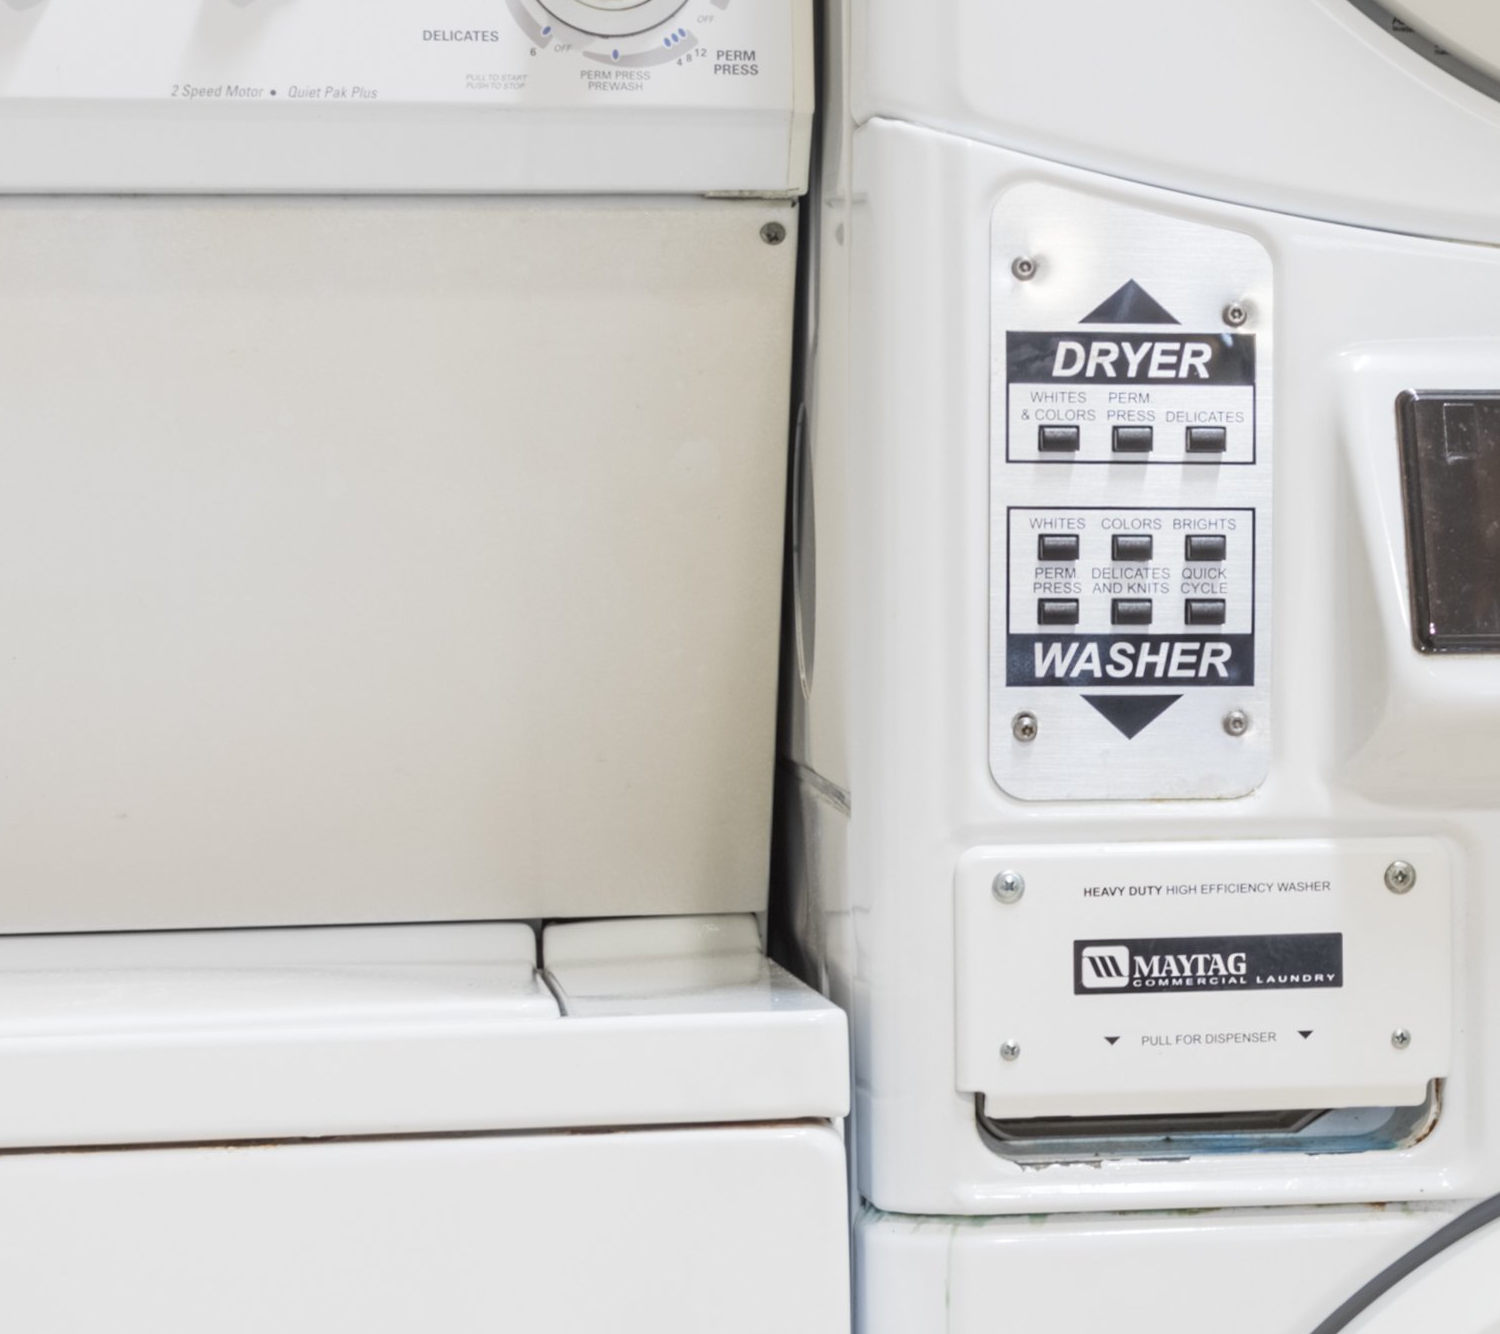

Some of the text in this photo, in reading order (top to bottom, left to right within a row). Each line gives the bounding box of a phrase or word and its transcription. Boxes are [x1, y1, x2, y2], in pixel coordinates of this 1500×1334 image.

[422, 30, 499, 42] DELICATES
[530, 48, 537, 56] 6
[676, 49, 707, 66] 4 8 12
[717, 50, 756, 62] PERM
[580, 70, 651, 81] PERM PRESS
[714, 63, 758, 76] PRESS
[588, 81, 644, 91] PREWASH
[171, 85, 378, 101] 2 Speed Motor Quiet Pak Plus
[1052, 342, 1212, 378] DRYER
[1030, 391, 1086, 404] WHITES
[1021, 409, 1096, 422] & COLORS
[1107, 410, 1156, 422] PRESS
[1166, 410, 1244, 424] DELICATES
[1030, 517, 1085, 530] WHITES
[1101, 517, 1162, 531] COLORS
[1173, 517, 1237, 531] BRIGHTS
[1092, 567, 1170, 580] DELICATES
[1182, 567, 1227, 581] QUICK
[1033, 582, 1082, 595] PRESS
[1093, 582, 1170, 595] AND KNITS
[1180, 582, 1228, 595] CYCLE
[1034, 642, 1232, 678] WASHER
[1084, 881, 1331, 897] HEAVY DUTY HIGH EFFICIENCY WASHER
[1134, 953, 1246, 977] MAYTAG
[1133, 972, 1336, 987] COMMERCIAL LAUNDRY
[1142, 1032, 1276, 1046] PULL FOR DISPENSER
